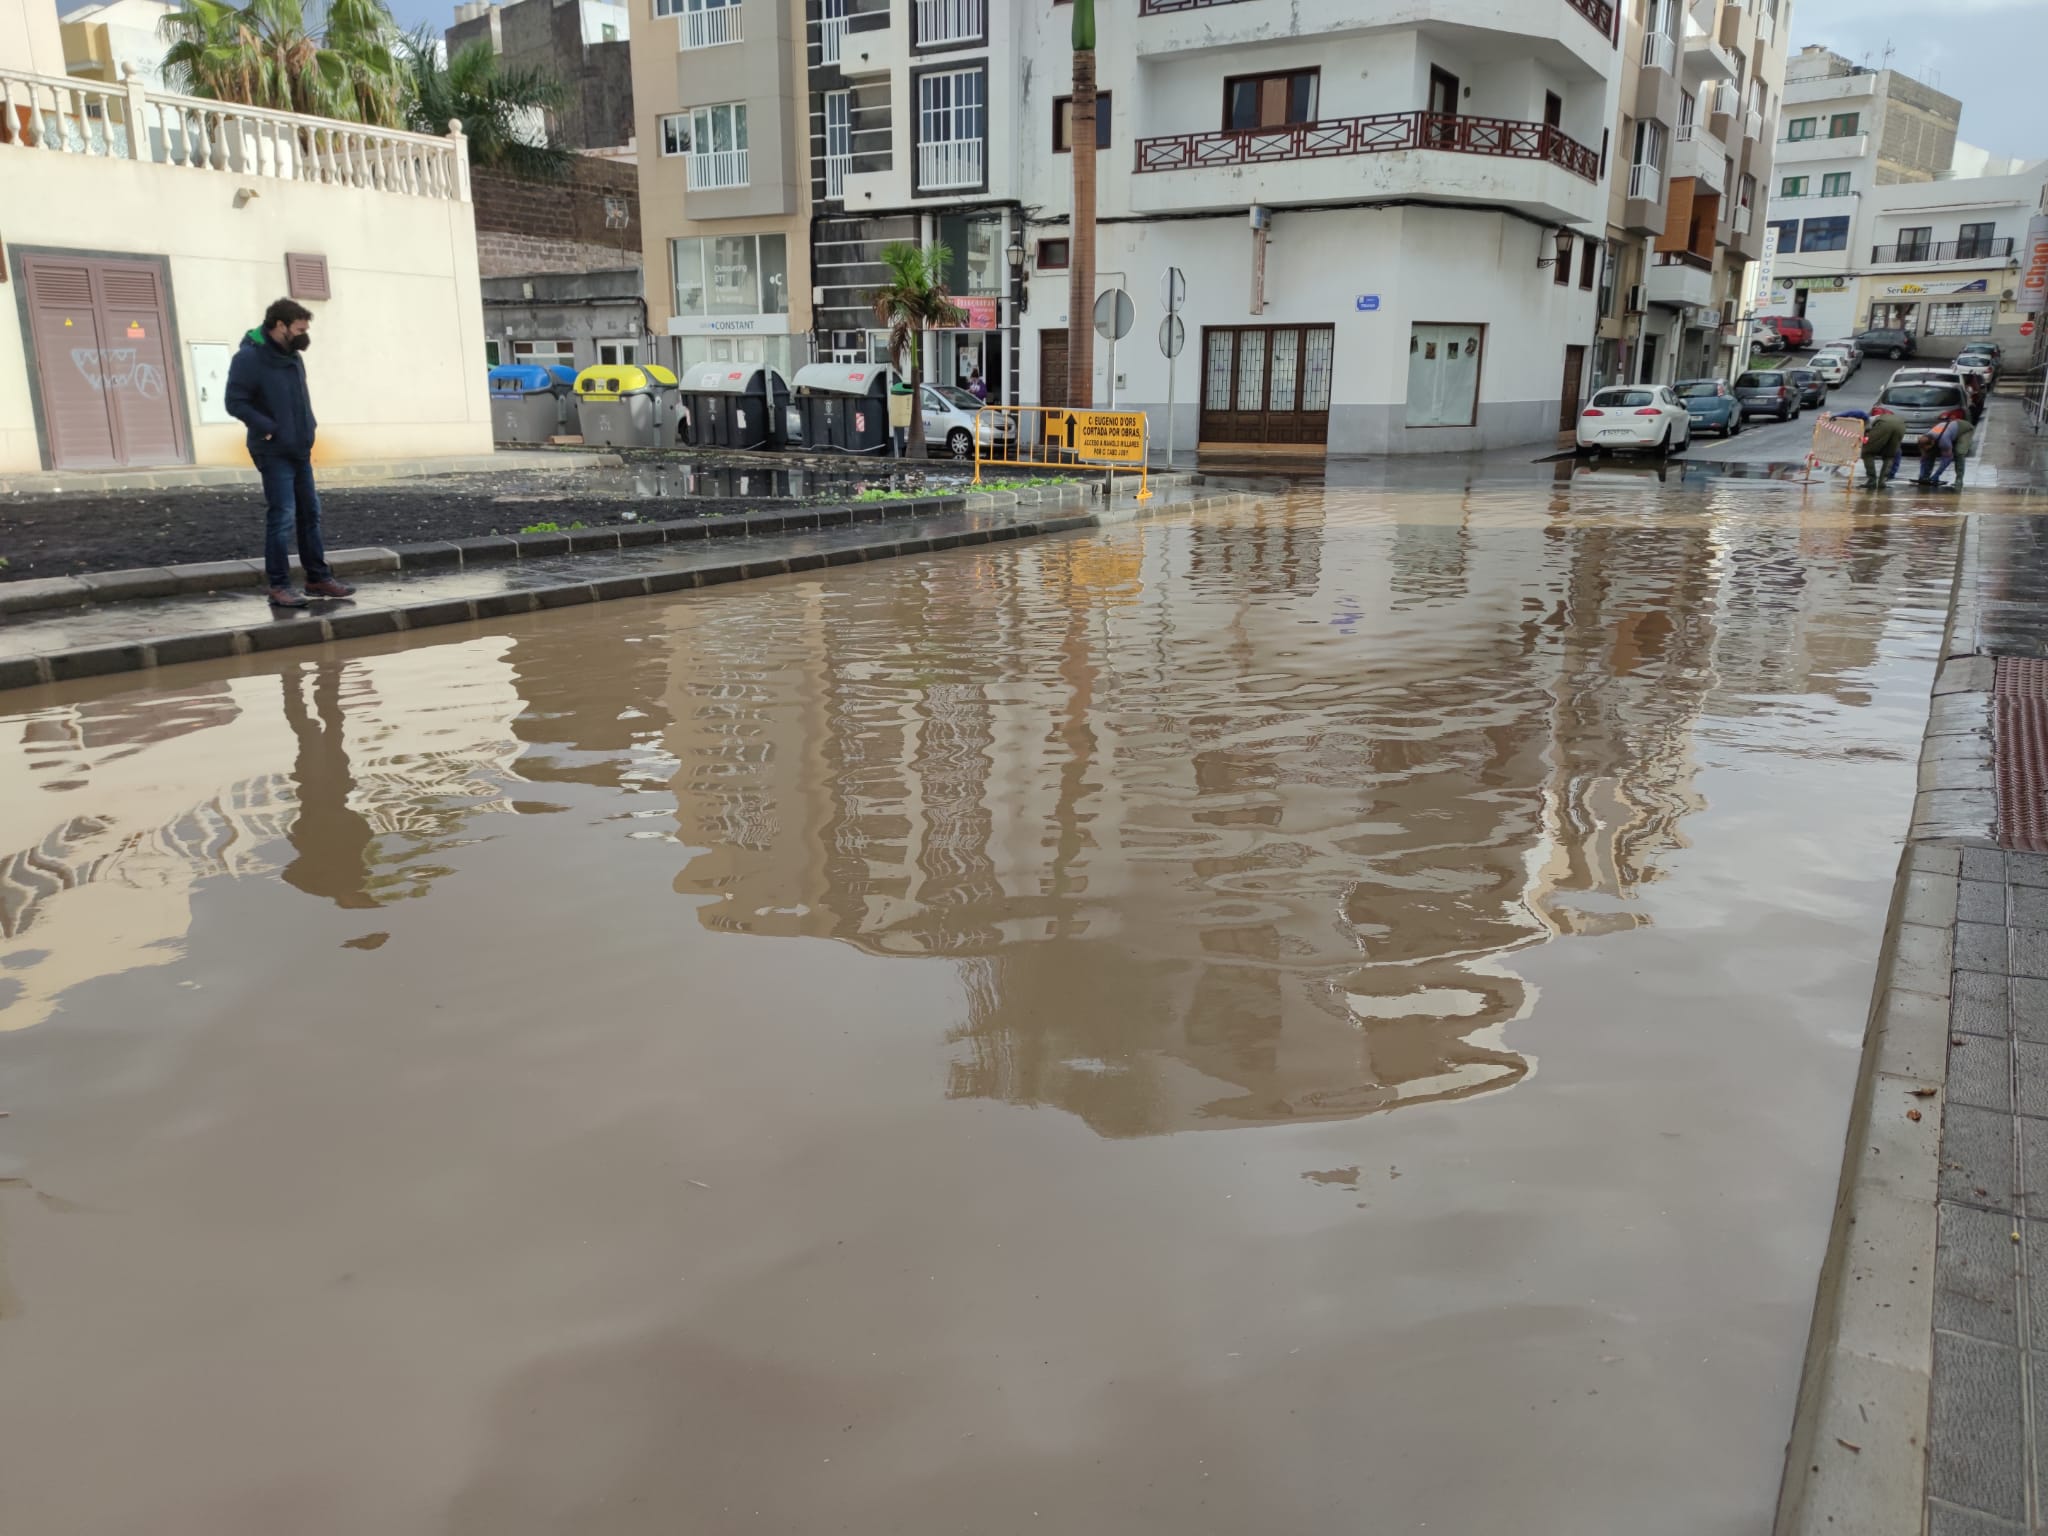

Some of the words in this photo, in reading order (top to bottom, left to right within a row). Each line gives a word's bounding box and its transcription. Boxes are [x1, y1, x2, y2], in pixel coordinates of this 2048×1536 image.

[1759, 229, 1774, 297] LOCUTORIO
[714, 320, 755, 330] CONSTANT
[1095, 416, 1118, 426] EUGENIO
[1120, 417, 1136, 427] D'ORS
[1083, 427, 1107, 436] CORTADA
[1109, 428, 1119, 436] POR
